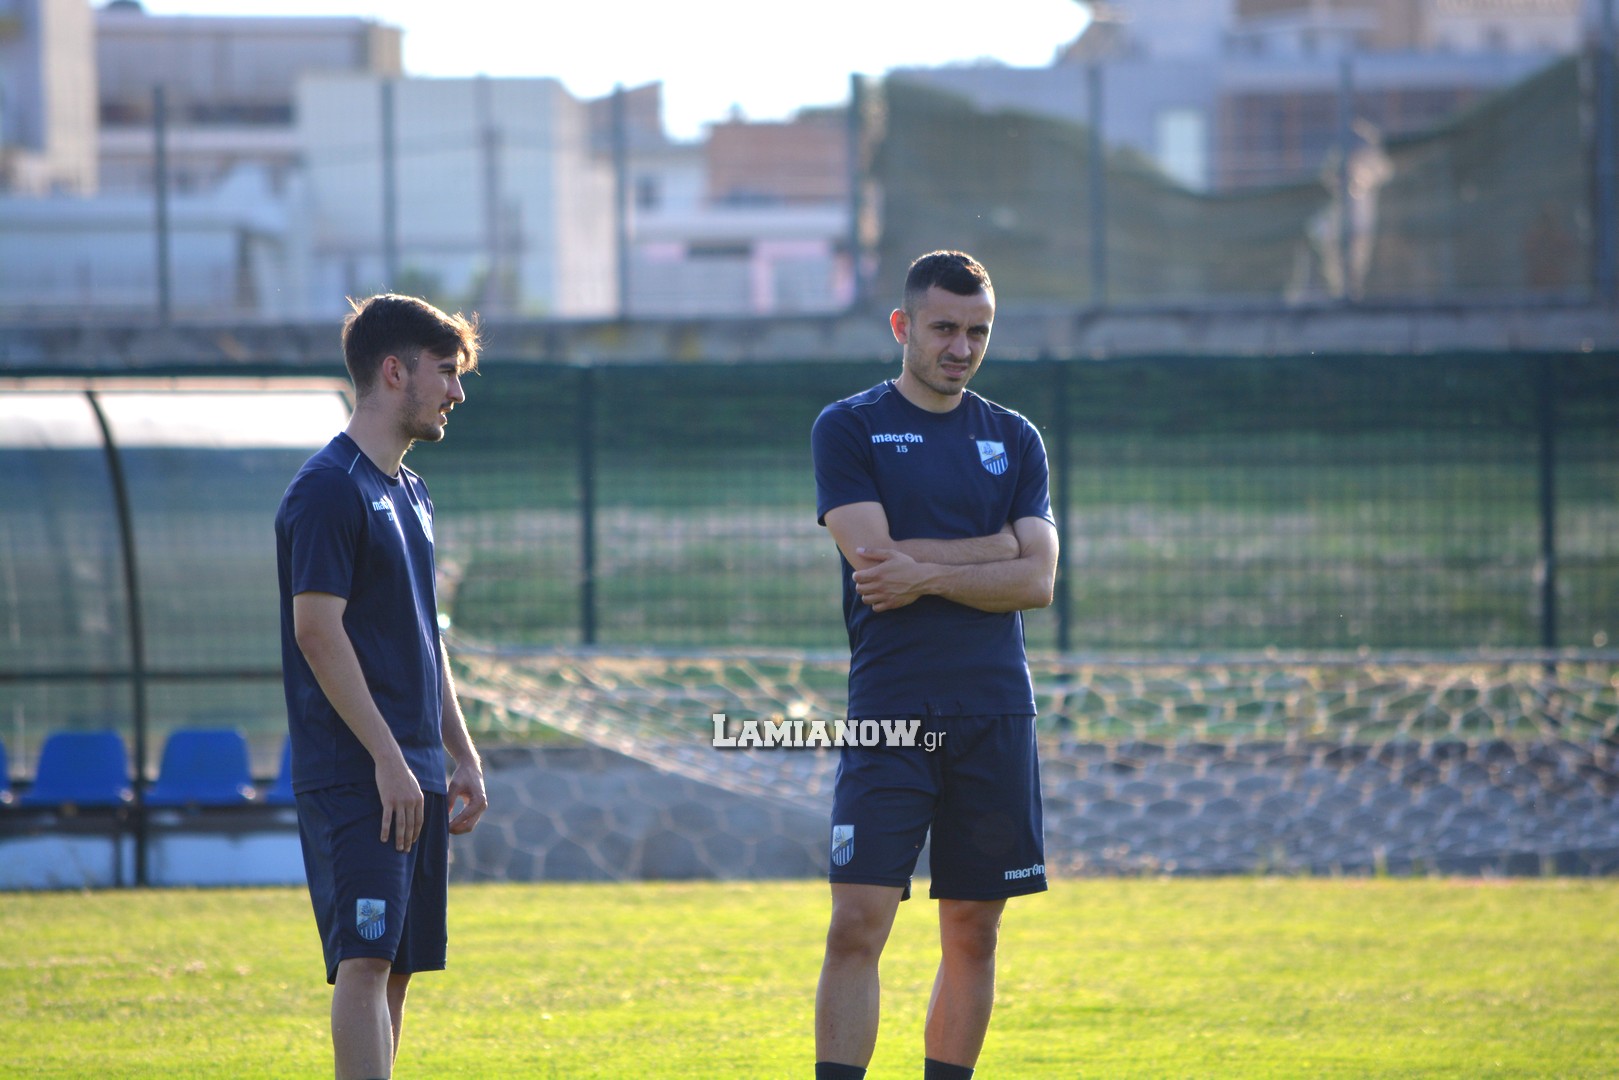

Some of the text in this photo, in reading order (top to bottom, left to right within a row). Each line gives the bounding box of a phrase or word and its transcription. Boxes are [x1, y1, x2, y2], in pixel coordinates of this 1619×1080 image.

[871, 433, 923, 443] macron
[895, 445, 908, 453] 15
[1004, 864, 1045, 880] macron
